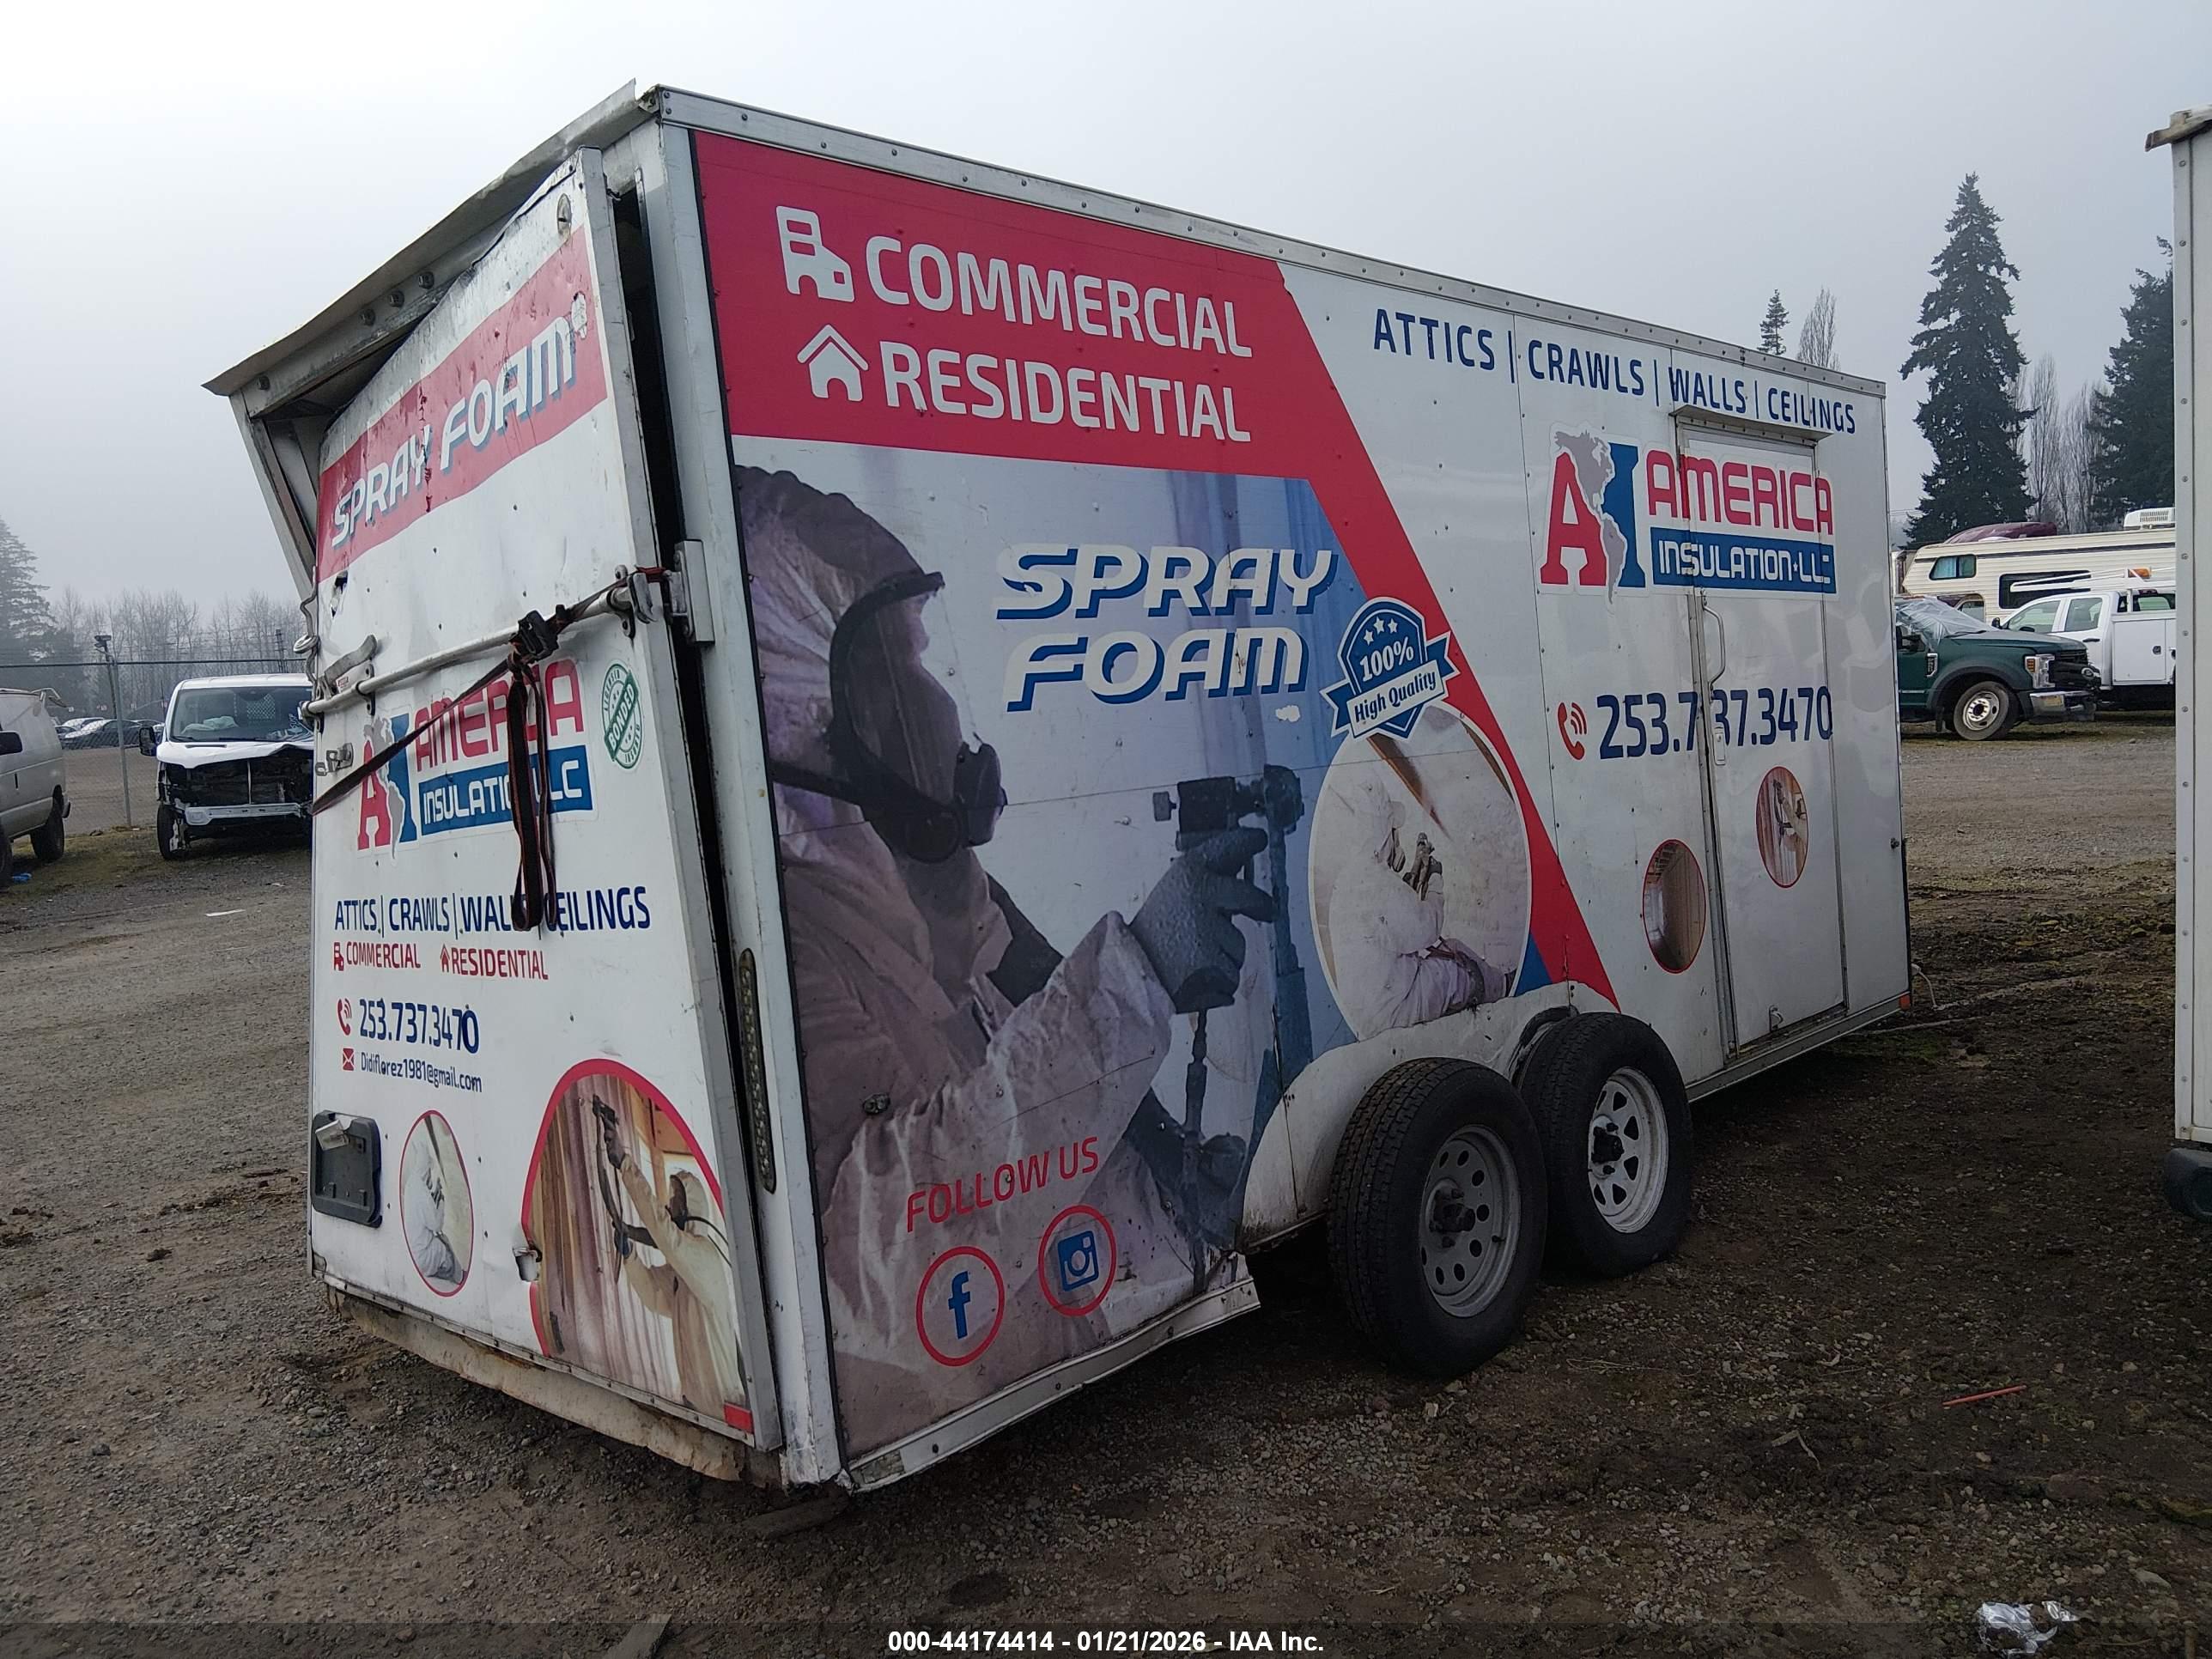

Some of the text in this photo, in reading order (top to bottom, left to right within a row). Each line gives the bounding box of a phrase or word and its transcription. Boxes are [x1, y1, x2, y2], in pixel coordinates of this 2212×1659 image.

[866, 234, 1253, 358] COMMERCIAL
[879, 341, 1251, 442] RESIDENTIAL
[1374, 308, 1495, 370] ATTICS
[1528, 339, 1644, 397] CRAWLS
[1668, 366, 1747, 414] WALLS
[1767, 387, 1856, 434] CEILINGS
[331, 316, 576, 548] SPRAY FOAM
[1646, 449, 1833, 536] AMERICA
[992, 543, 1338, 620] SPRAY
[1659, 540, 1792, 582] INSULATION
[1002, 627, 1310, 713] FOAM
[1359, 636, 1414, 683] 100%
[414, 659, 585, 773] AMERA
[609, 684, 635, 751] BONDED
[1354, 672, 1437, 723] High Quality
[1596, 686, 1833, 760] 253.737.3470
[423, 774, 513, 825] INSULATI
[334, 898, 377, 933] ATTICS
[388, 896, 450, 933] CRAWLS
[460, 896, 531, 933] WAL
[544, 886, 651, 933] CEILINGS
[346, 942, 421, 969] COMMERCIAL
[451, 947, 549, 981] RESIDENTIAL
[359, 999, 480, 1054] 253.737.3470
[361, 1052, 483, 1093] Didiflorez1981@gmail.com
[906, 1136, 1099, 1233] FOLLOW US
